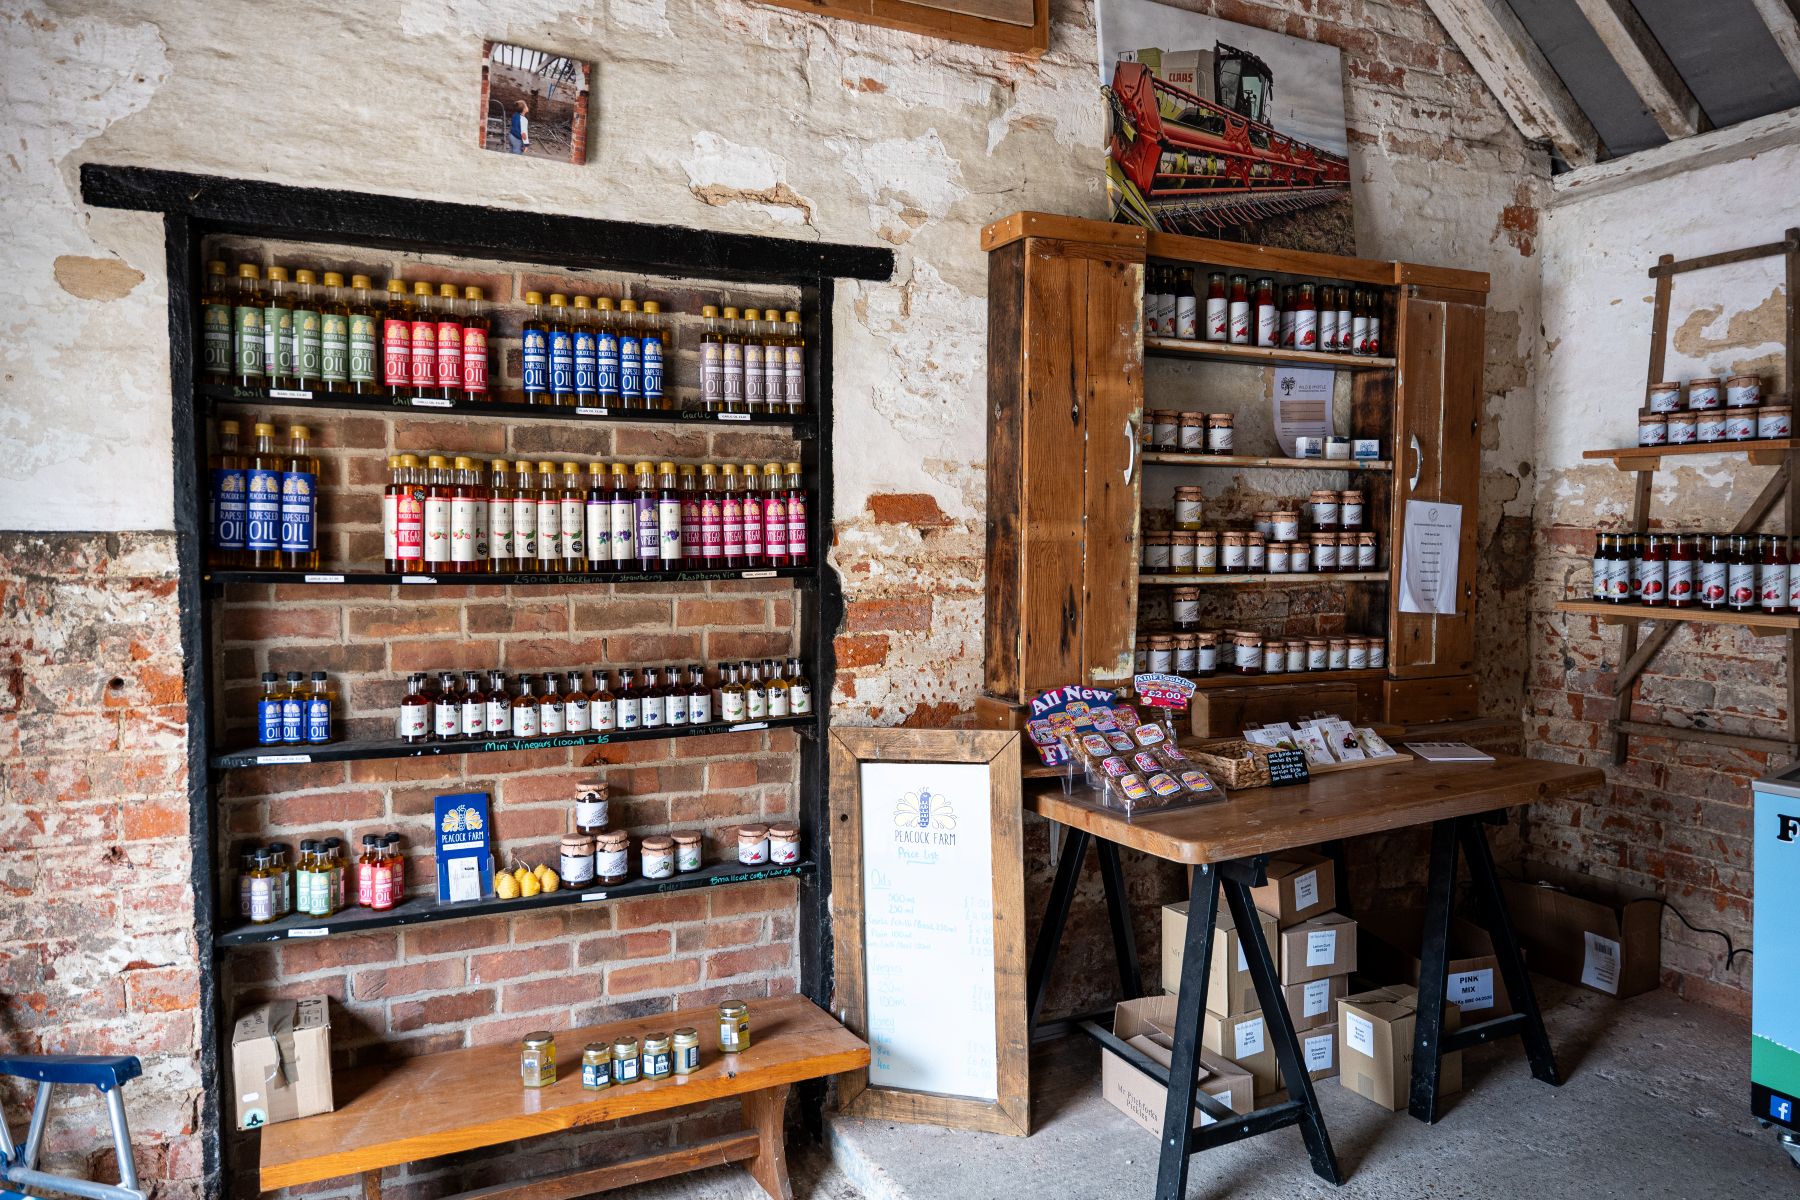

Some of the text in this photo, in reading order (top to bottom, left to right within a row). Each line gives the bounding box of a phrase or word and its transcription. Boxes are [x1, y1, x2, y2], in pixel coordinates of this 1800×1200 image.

[1168, 72, 1193, 83] CLAAS
[324, 356, 347, 372] OIL
[352, 357, 374, 372] OIL
[387, 361, 408, 376] OIL
[413, 362, 434, 377] OIL
[439, 363, 460, 377] OIL
[465, 368, 485, 382] OIL
[525, 369, 545, 384] OIL
[555, 371, 573, 386] OIL
[577, 371, 595, 386] OIL
[599, 372, 618, 387] OIL
[622, 375, 640, 390] OIL
[645, 376, 663, 390] OIL
[724, 381, 742, 394] OIL
[747, 382, 764, 396] OIL
[233, 386, 264, 398] Basil
[250, 512, 278, 520] RAPESEED
[220, 521, 244, 540] OIL
[250, 521, 278, 540] OIL
[282, 523, 309, 542] OIL
[398, 530, 420, 542] VINEGAR
[768, 531, 785, 542] VINEGAR
[1032, 686, 1113, 716] All New
[1148, 691, 1180, 700] £2.00
[284, 726, 299, 738] OIL
[311, 727, 327, 737] OIL
[485, 742, 508, 751] Mini
[442, 831, 484, 843] PEACOCK FARM
[894, 830, 956, 846] PEACOCK FARM
[898, 847, 919, 858] Price
[871, 868, 892, 886] Oils
[376, 892, 391, 902] OIL
[1462, 986, 1476, 994] MIX
[1118, 1082, 1158, 1121] Mr Pitchforks
[1127, 1099, 1148, 1122] Pickles
